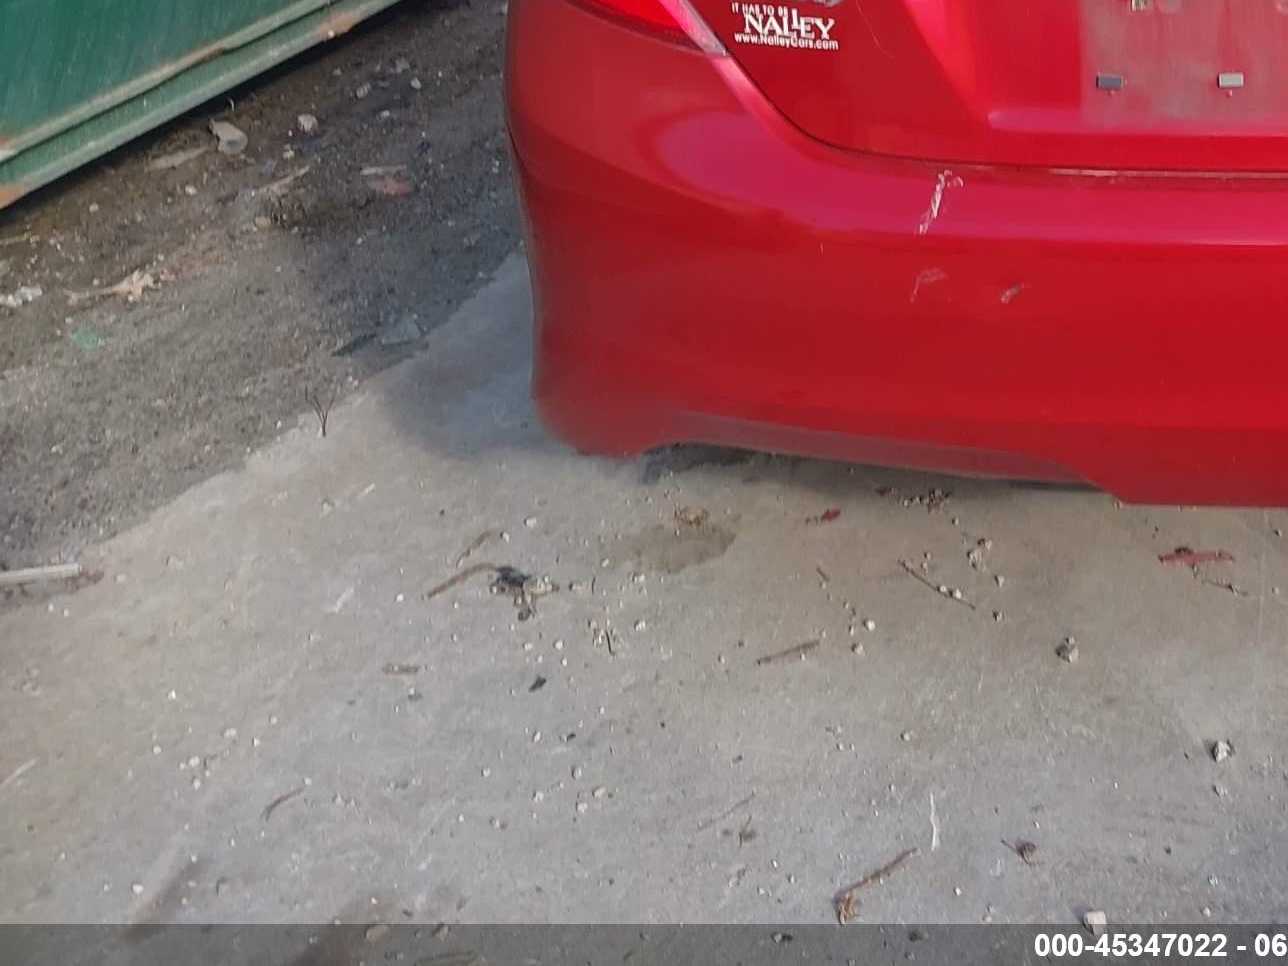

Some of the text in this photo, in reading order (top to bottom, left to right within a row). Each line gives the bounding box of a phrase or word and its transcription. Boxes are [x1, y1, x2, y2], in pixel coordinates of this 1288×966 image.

[732, 1, 788, 18] IT HAS TO BE
[734, 32, 839, 50] www.NalleyCars.com
